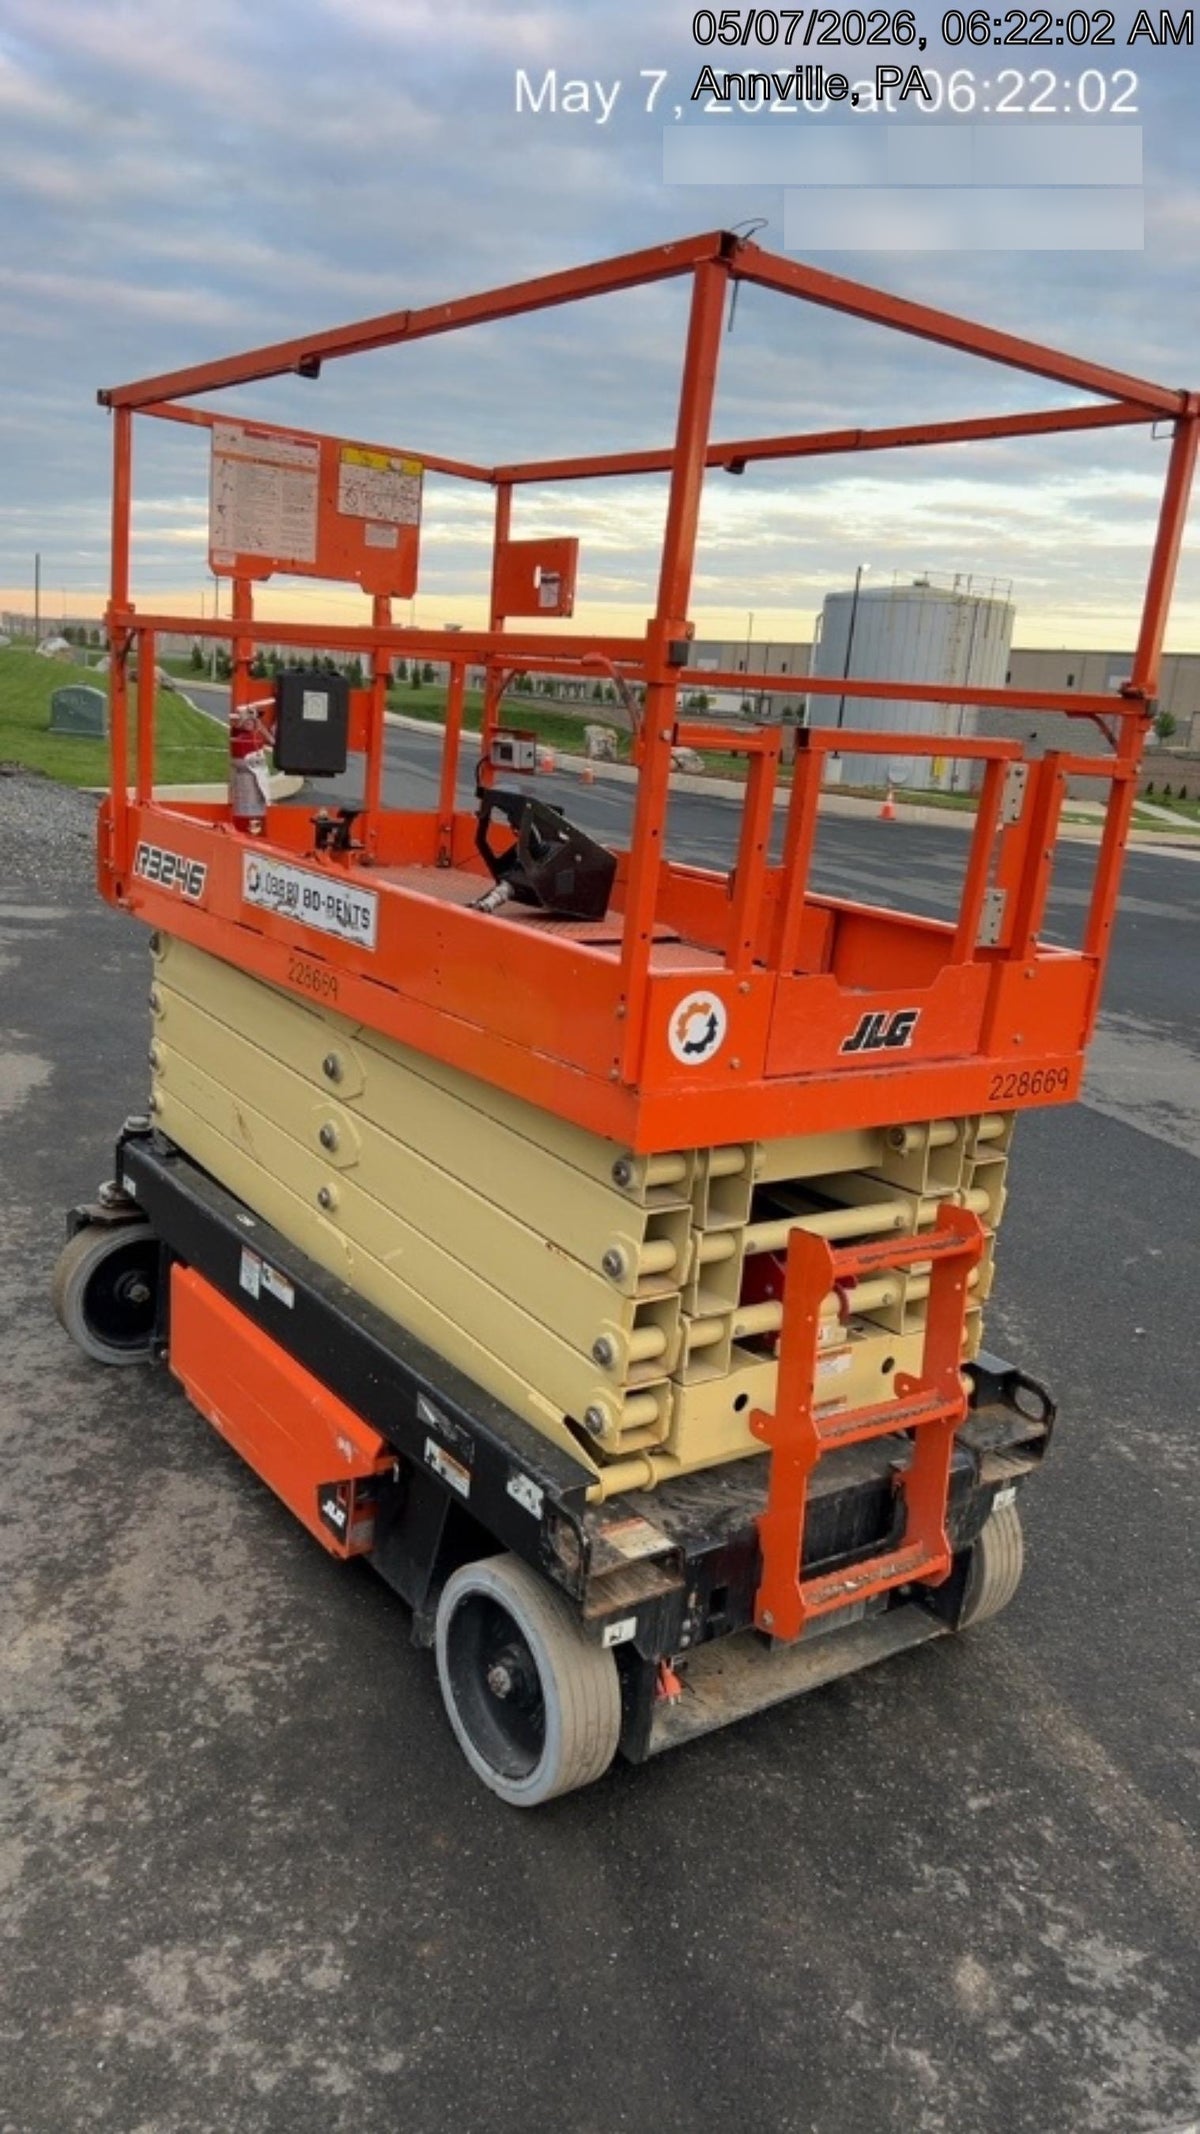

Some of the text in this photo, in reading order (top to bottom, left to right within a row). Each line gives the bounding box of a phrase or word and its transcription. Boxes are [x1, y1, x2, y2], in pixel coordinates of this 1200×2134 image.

[133, 841, 207, 899] R3246
[838, 1007, 922, 1056] JLG
[988, 1066, 1069, 1101] 228669
